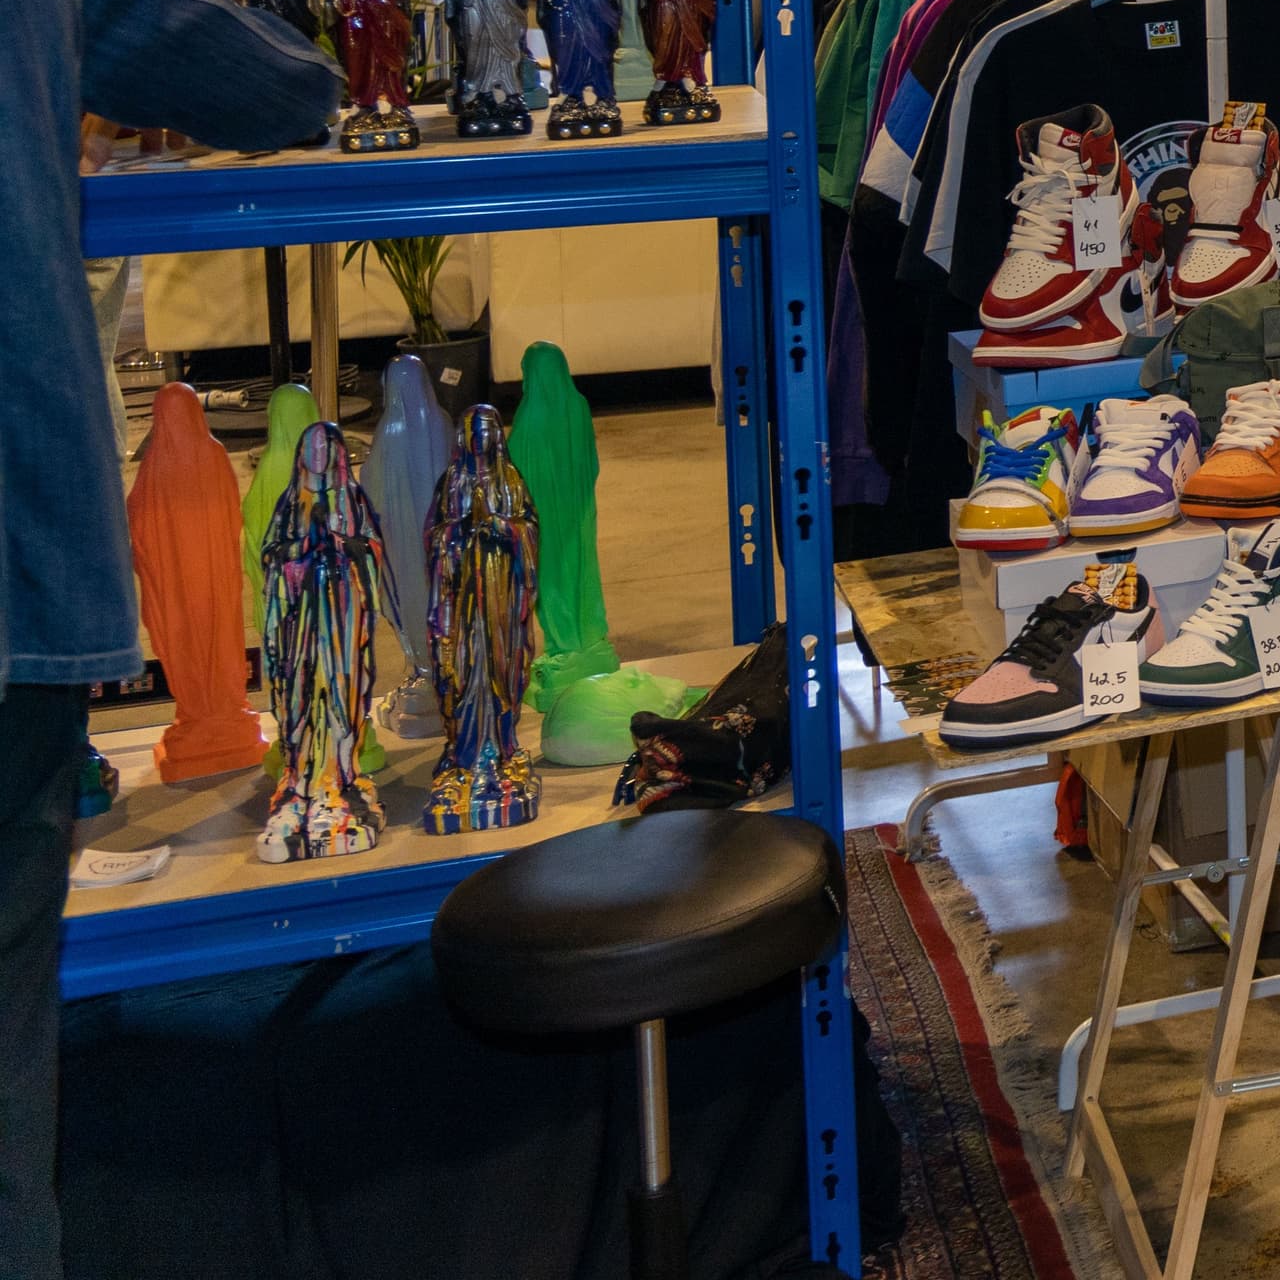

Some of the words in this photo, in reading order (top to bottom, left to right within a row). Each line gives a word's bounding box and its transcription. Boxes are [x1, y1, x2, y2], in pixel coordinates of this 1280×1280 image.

[1080, 241, 1106, 256] 450
[1089, 671, 1127, 686] 42.5
[1090, 693, 1125, 707] 200
